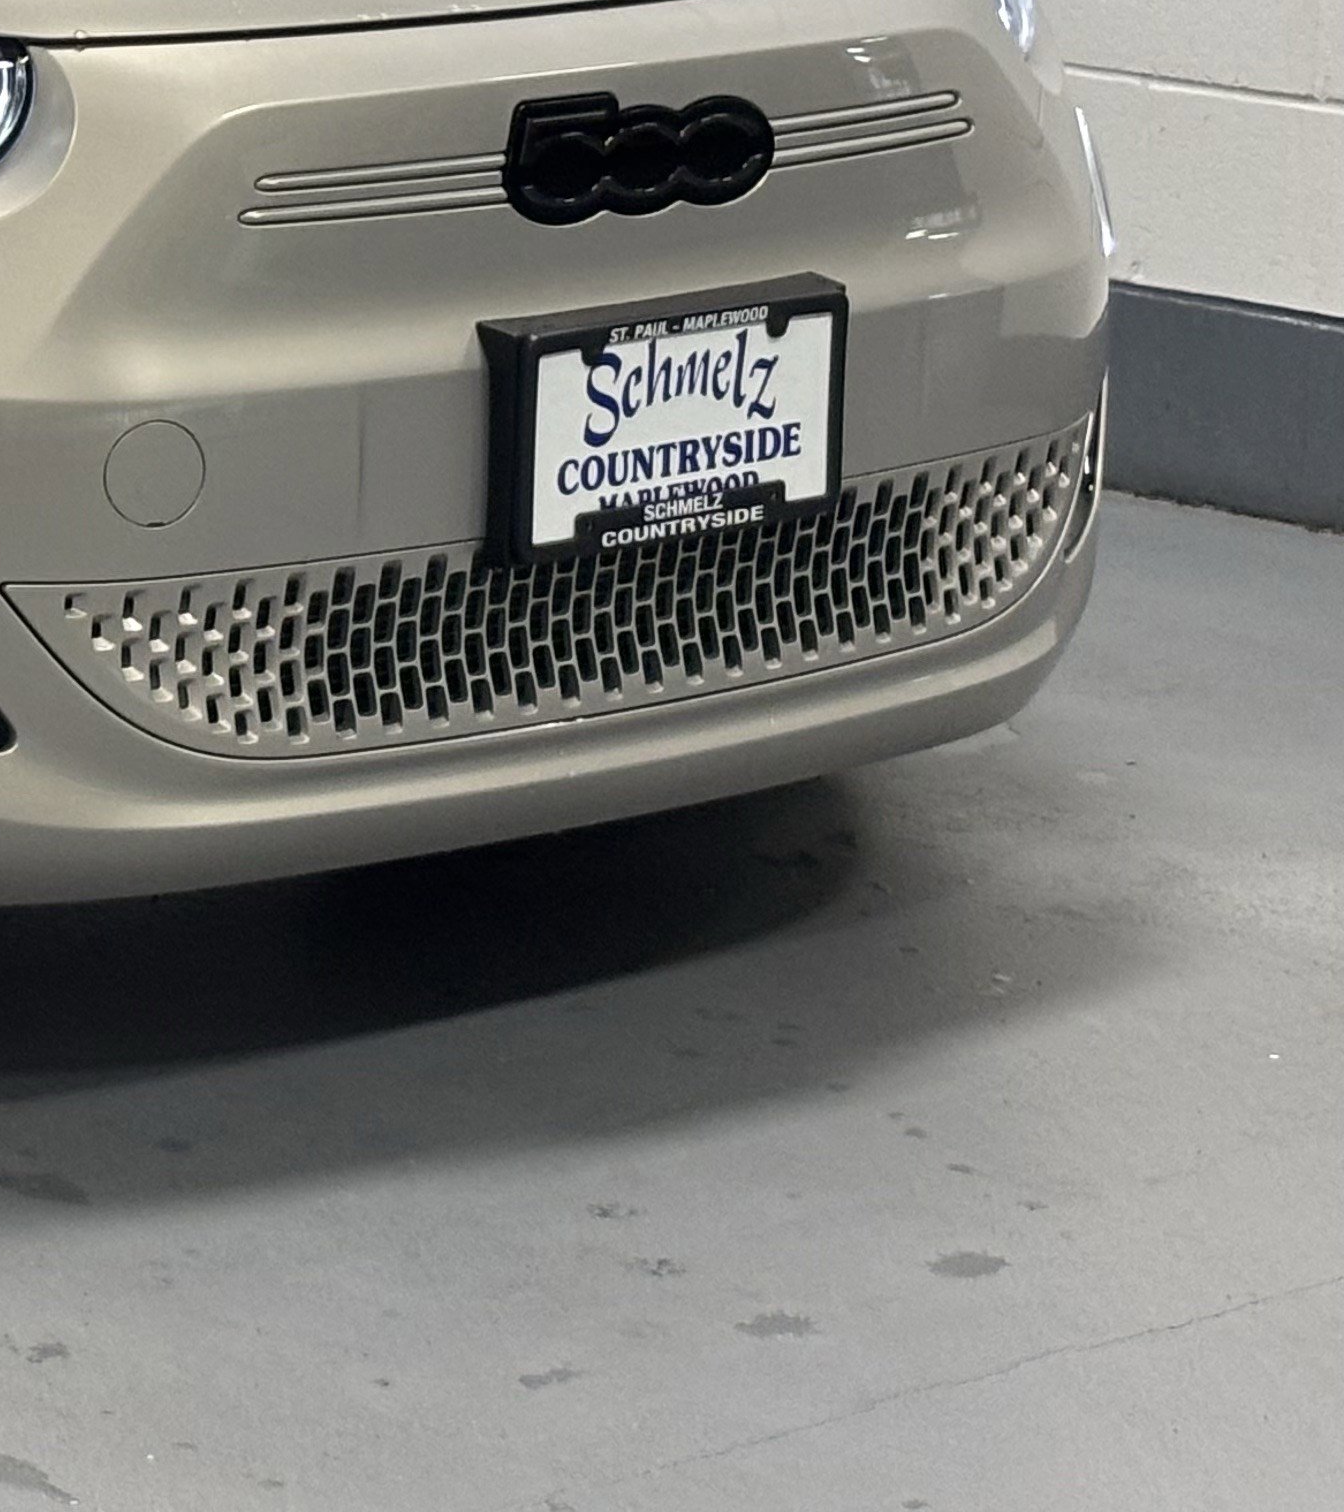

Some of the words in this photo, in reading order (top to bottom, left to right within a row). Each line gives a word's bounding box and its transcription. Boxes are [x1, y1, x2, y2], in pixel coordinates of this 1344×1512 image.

[502, 91, 775, 226] 500
[610, 327, 632, 343] ST.
[634, 320, 668, 339] PAUL
[683, 306, 769, 332] MAPLEWOOD
[583, 329, 779, 447] Schmelz
[557, 422, 801, 495] COUNTRYSIDE
[602, 505, 765, 548] COUNTRYSIDE
[644, 493, 724, 522] SCHMELZ
